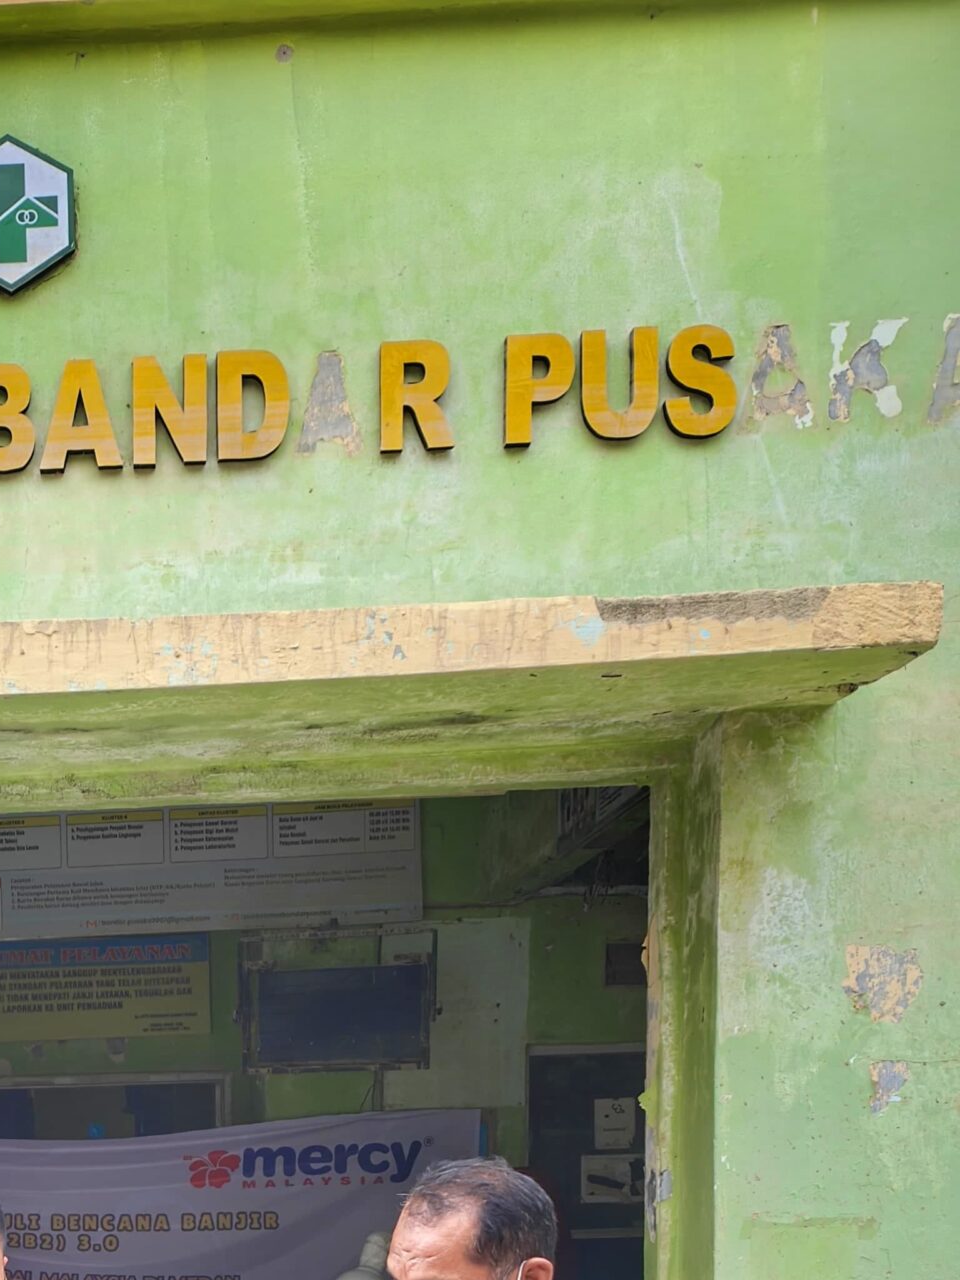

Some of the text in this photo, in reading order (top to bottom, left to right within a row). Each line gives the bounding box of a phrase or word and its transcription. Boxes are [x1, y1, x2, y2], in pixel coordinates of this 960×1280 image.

[60, 944, 193, 965] PELAYANAN
[242, 1140, 422, 1184] mercy
[242, 1176, 385, 1189] MALAYSIA
[51, 1214, 171, 1232] BENCANA
[181, 1211, 280, 1231] BANJIR
[77, 1234, 120, 1252] 3.0
